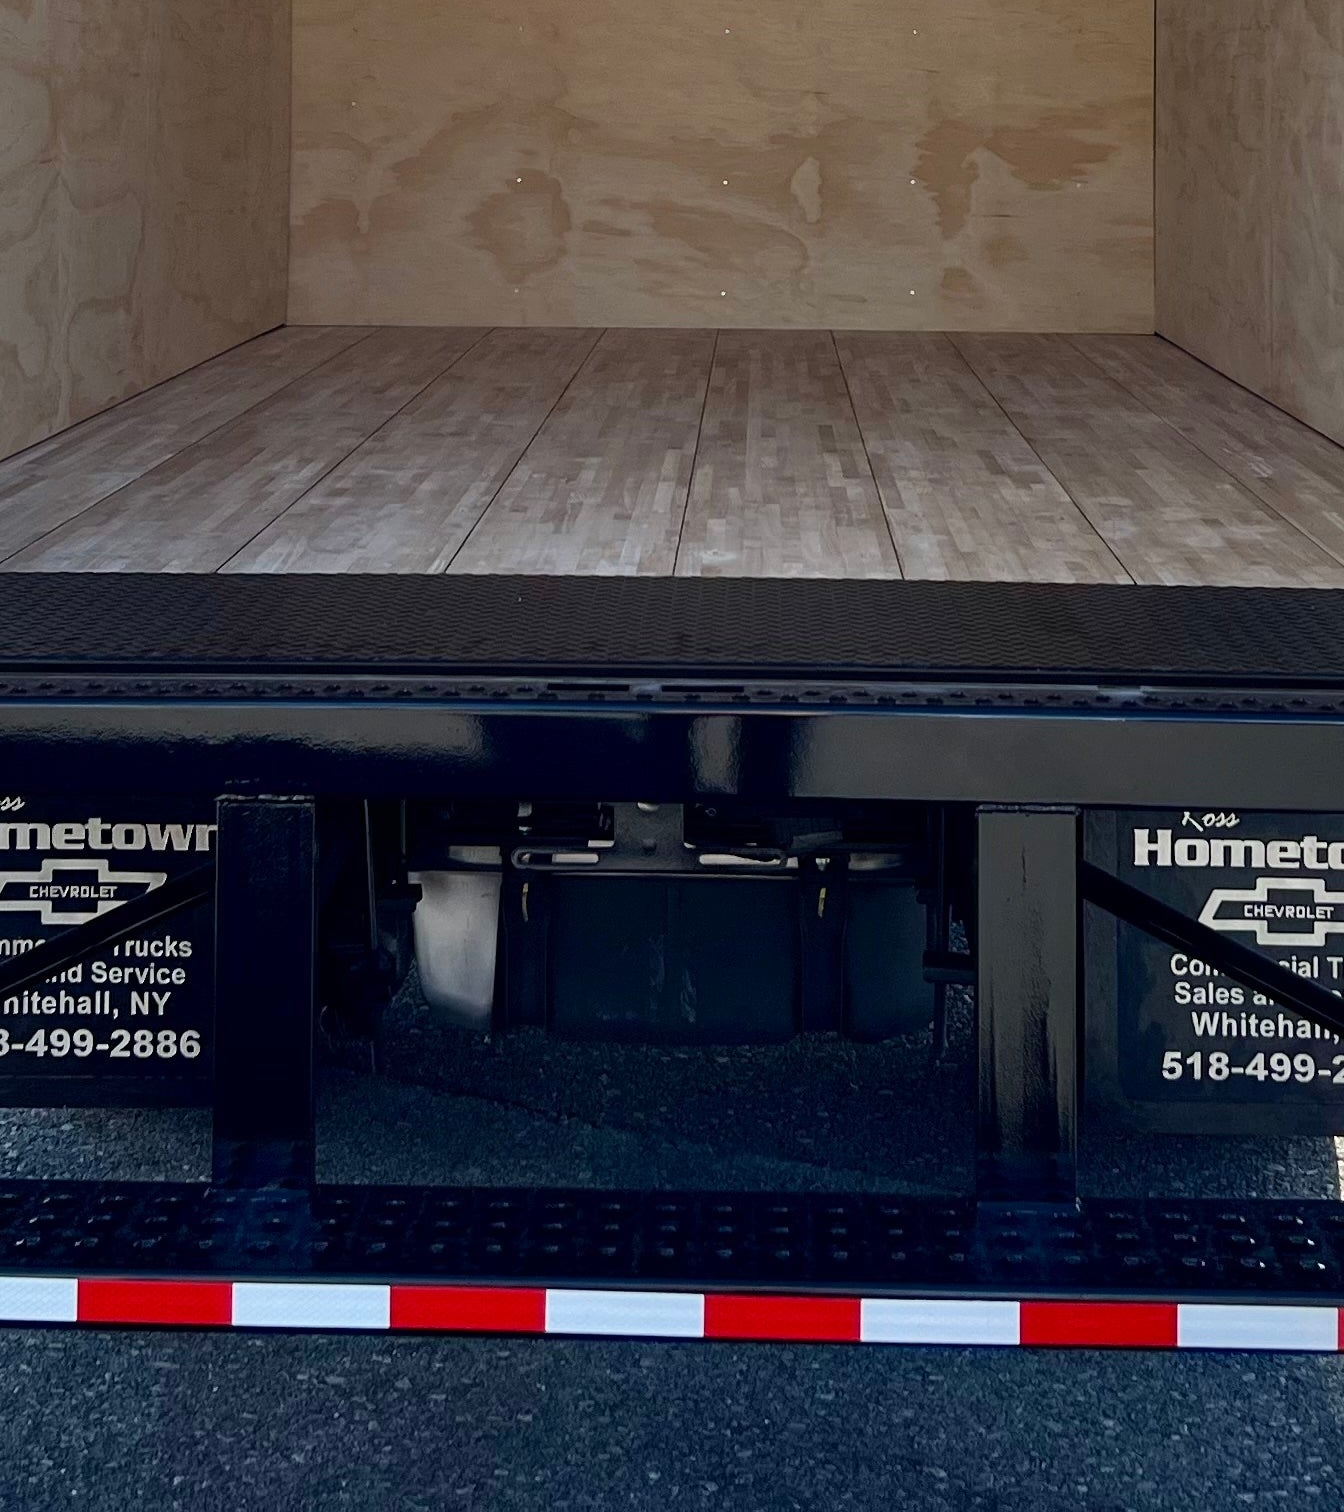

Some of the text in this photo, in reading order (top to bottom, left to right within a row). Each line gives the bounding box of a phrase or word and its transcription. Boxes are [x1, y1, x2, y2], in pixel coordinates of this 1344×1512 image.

[29, 886, 117, 898] CHEVROLET
[1244, 904, 1335, 919] CHEVROLET
[91, 961, 186, 985] Service
[130, 991, 171, 1016] NY
[1174, 982, 1244, 1004] Sales
